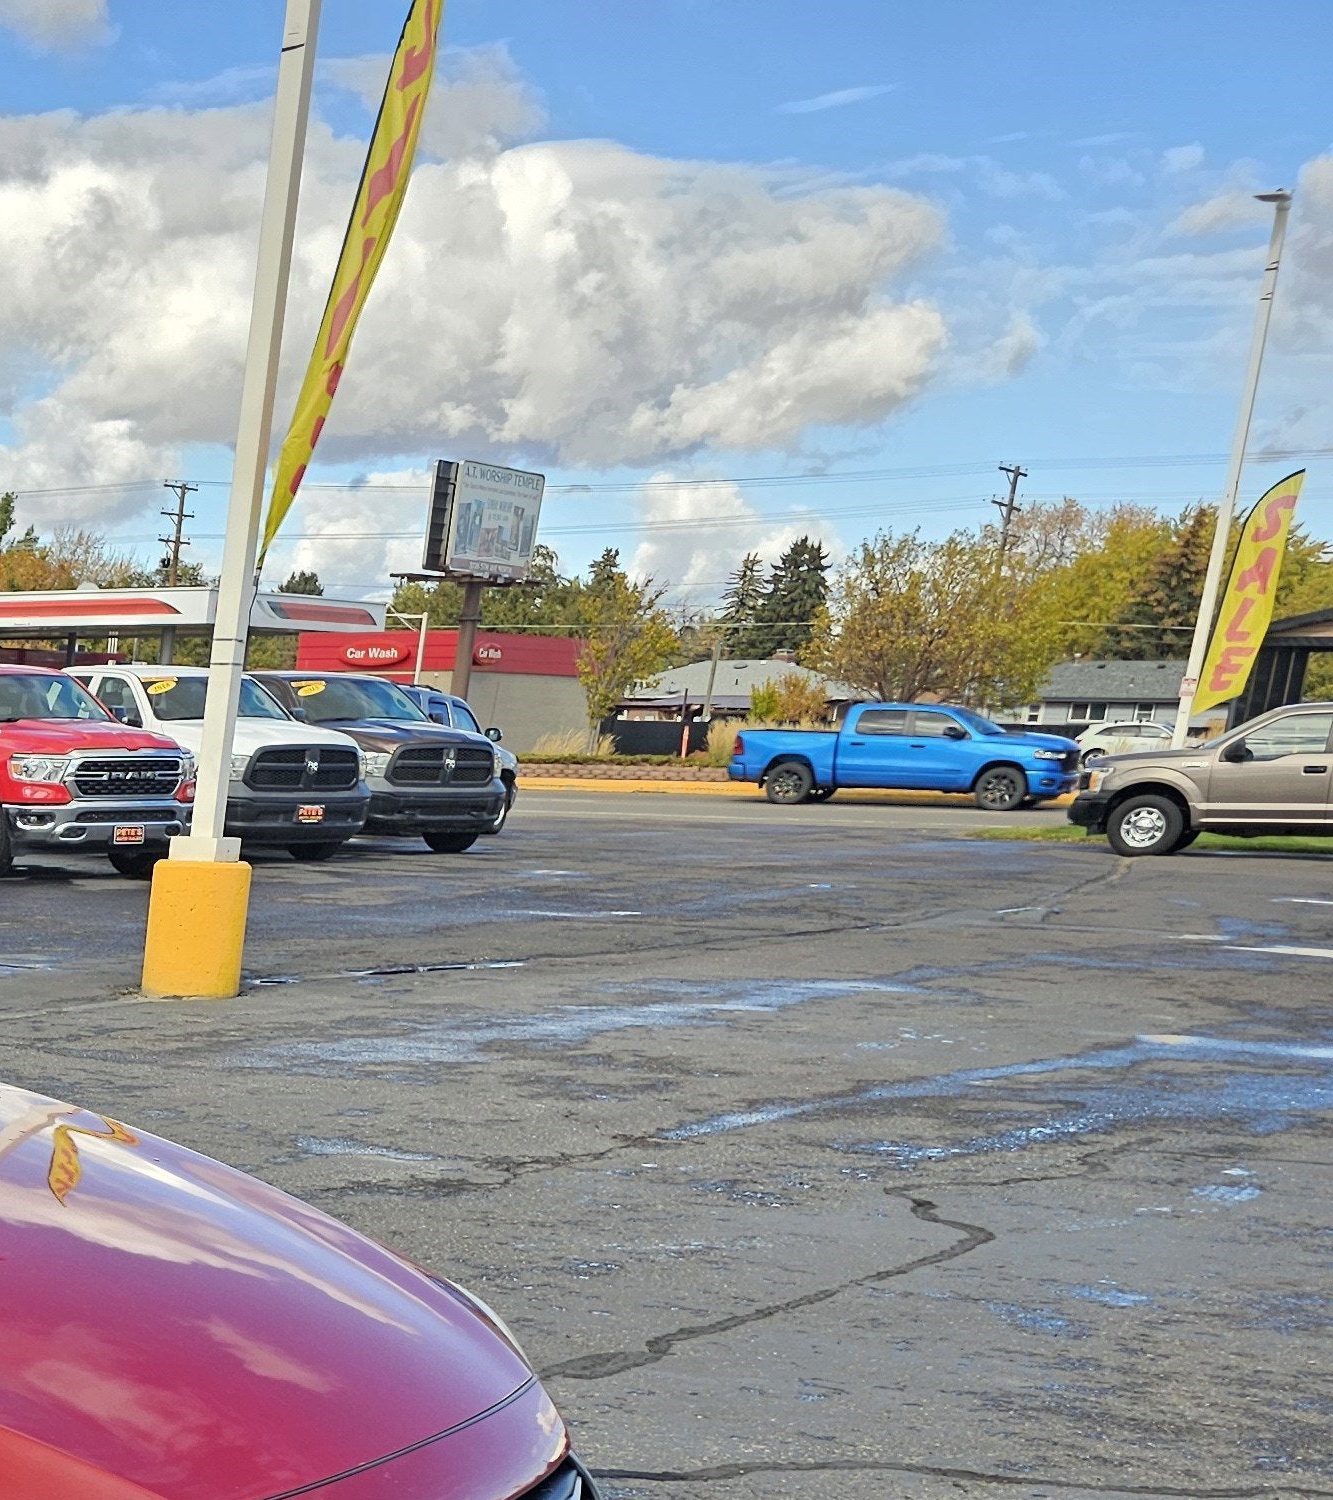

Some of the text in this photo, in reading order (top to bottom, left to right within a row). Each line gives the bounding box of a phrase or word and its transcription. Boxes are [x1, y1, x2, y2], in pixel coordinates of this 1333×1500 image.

[480, 467, 513, 485] WORSHIP
[514, 474, 541, 491] TEMPLE
[1209, 495, 1297, 692] SALE
[346, 647, 398, 659] Car Wash
